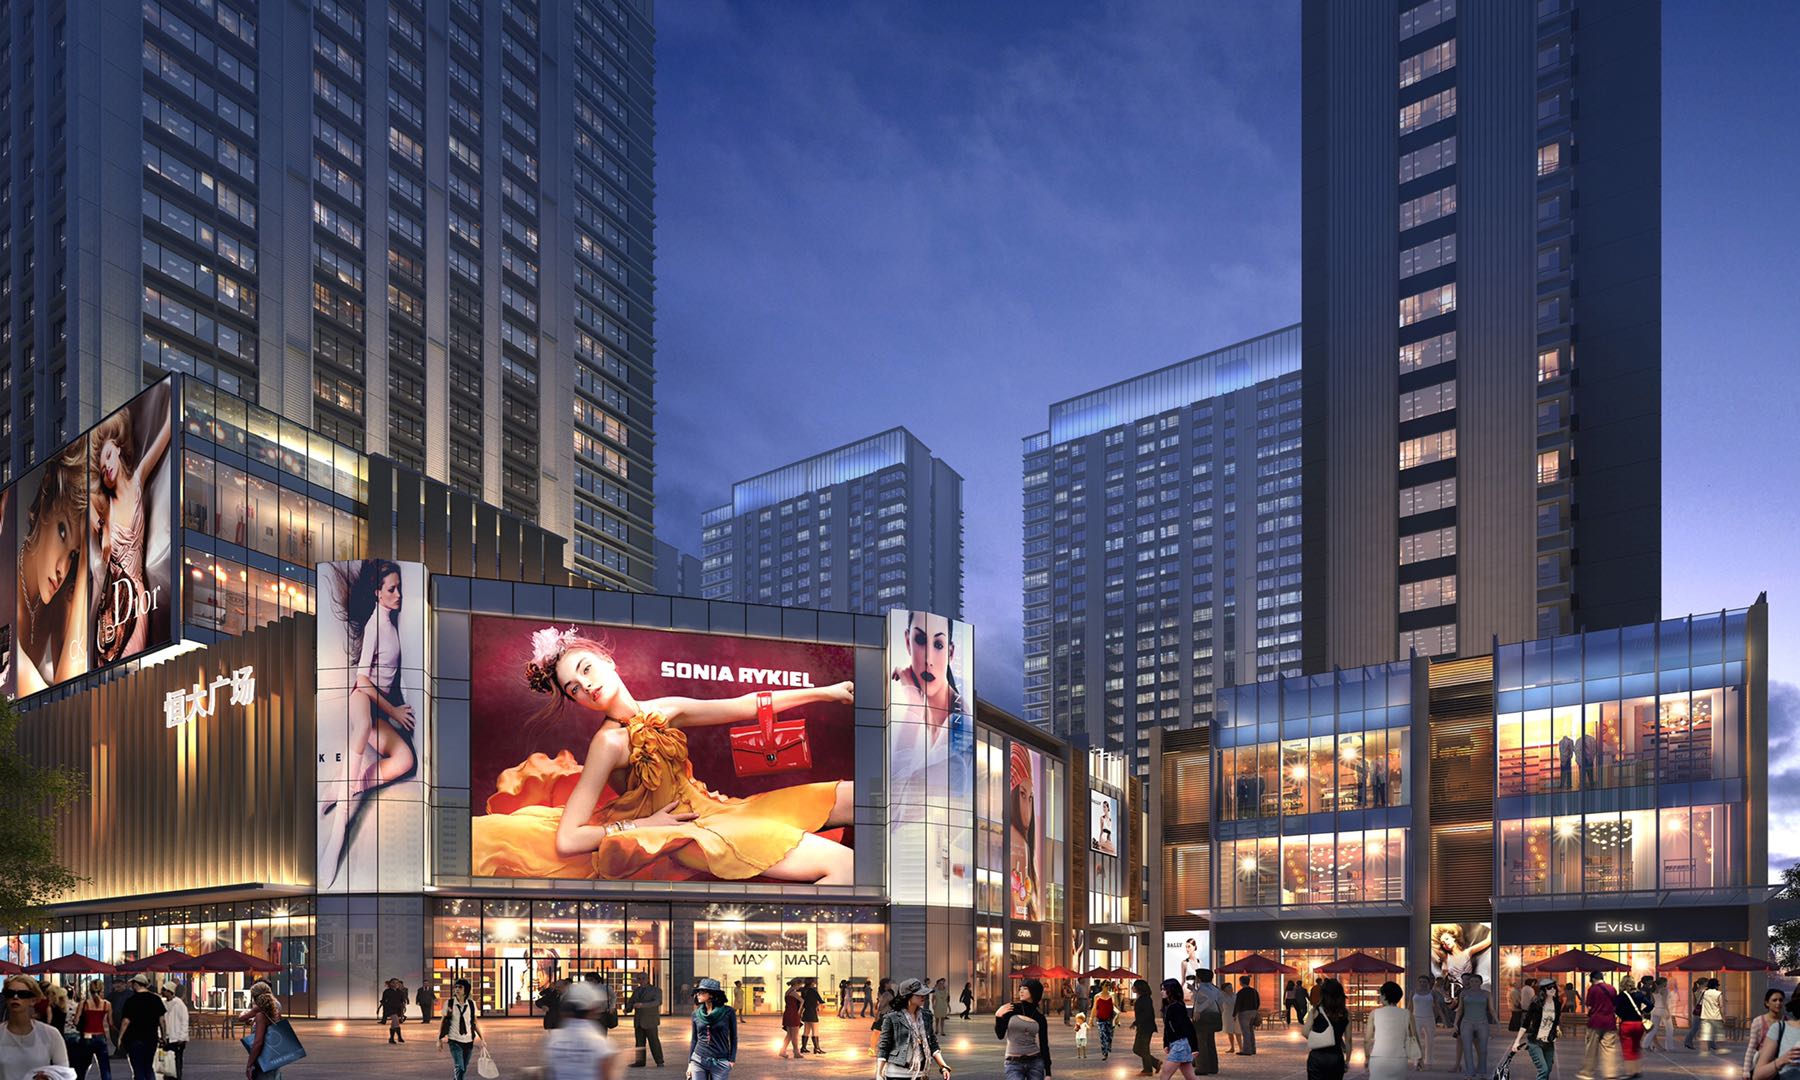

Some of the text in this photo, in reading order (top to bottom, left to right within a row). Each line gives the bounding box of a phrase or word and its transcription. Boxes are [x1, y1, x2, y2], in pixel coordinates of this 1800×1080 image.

[112, 577, 161, 627] Dior
[661, 661, 815, 688] SONIA RYKIEL
[163, 665, 255, 728] 恒大广场
[1594, 921, 1645, 933] Evisu
[1017, 929, 1032, 938] ZARA
[1279, 930, 1338, 940] Versace
[733, 954, 831, 966] MAY MARA
